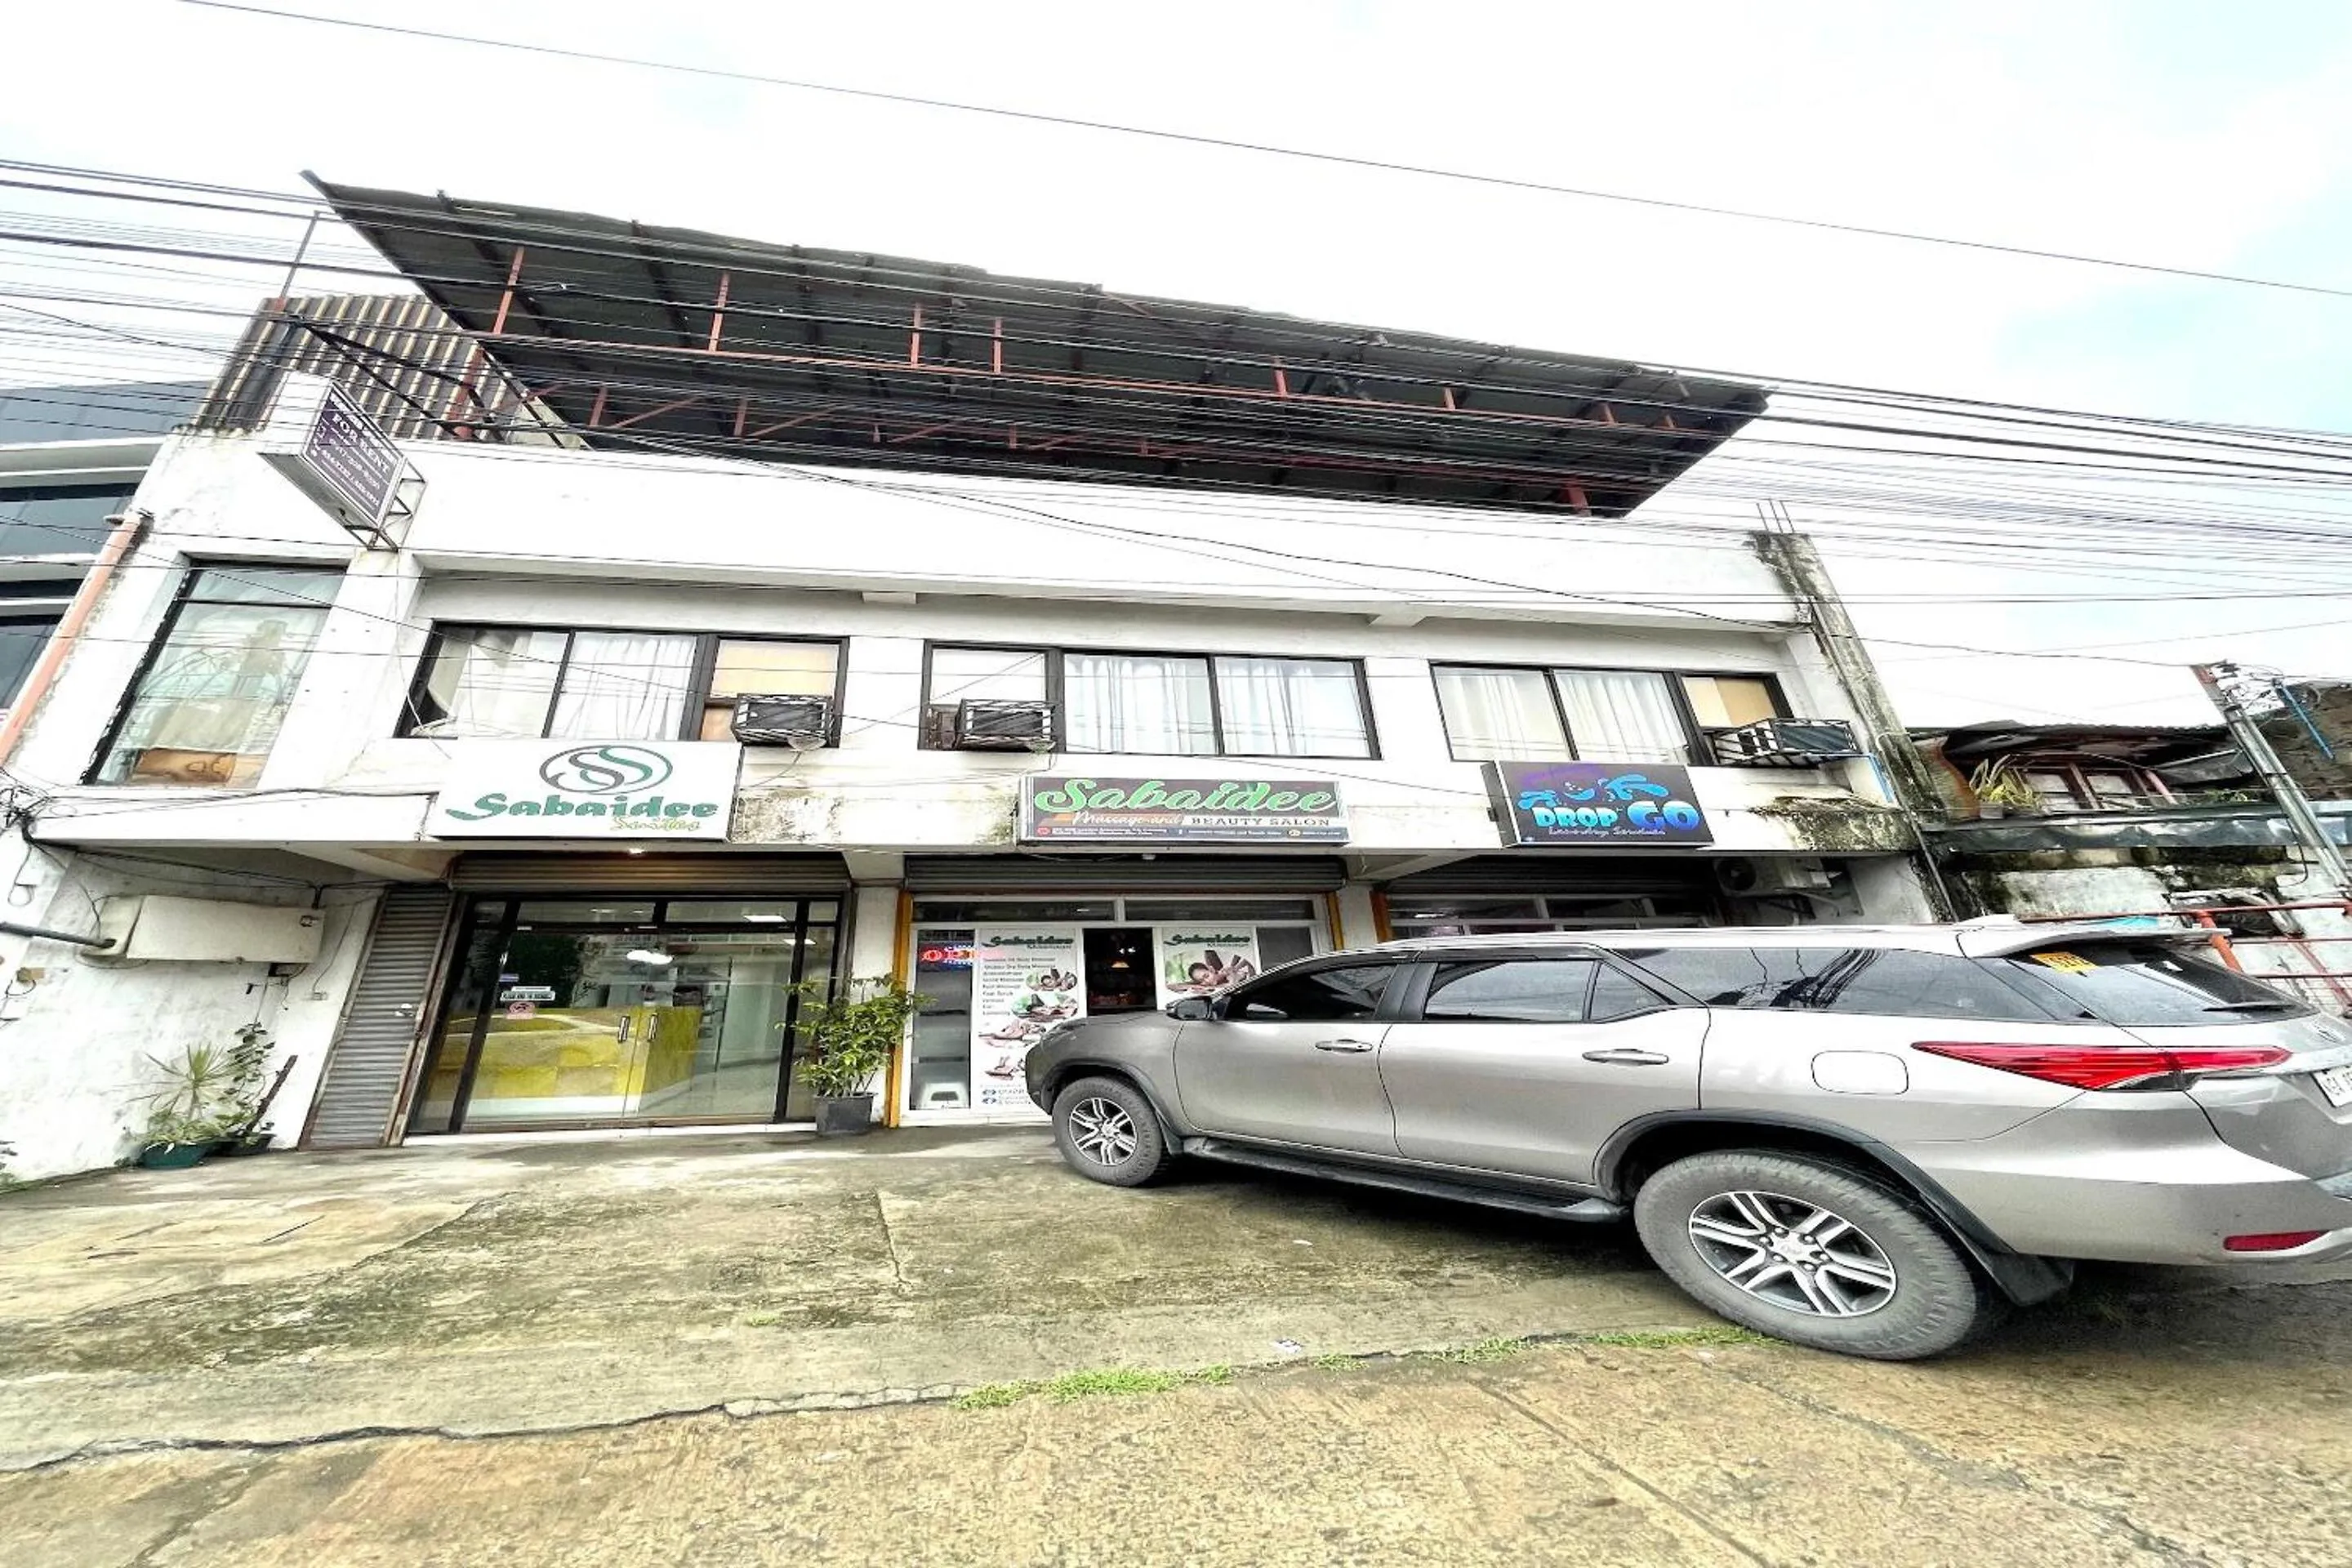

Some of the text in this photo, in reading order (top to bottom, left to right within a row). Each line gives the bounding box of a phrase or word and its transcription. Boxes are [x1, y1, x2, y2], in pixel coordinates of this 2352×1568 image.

[332, 413, 358, 442] FOR
[359, 439, 389, 472] RENT
[445, 792, 719, 821] Sabaidee
[1033, 778, 1338, 813] Sabaidee
[1191, 817, 1330, 826] BEAUTY SALON
[1531, 800, 1699, 831] DROP GO
